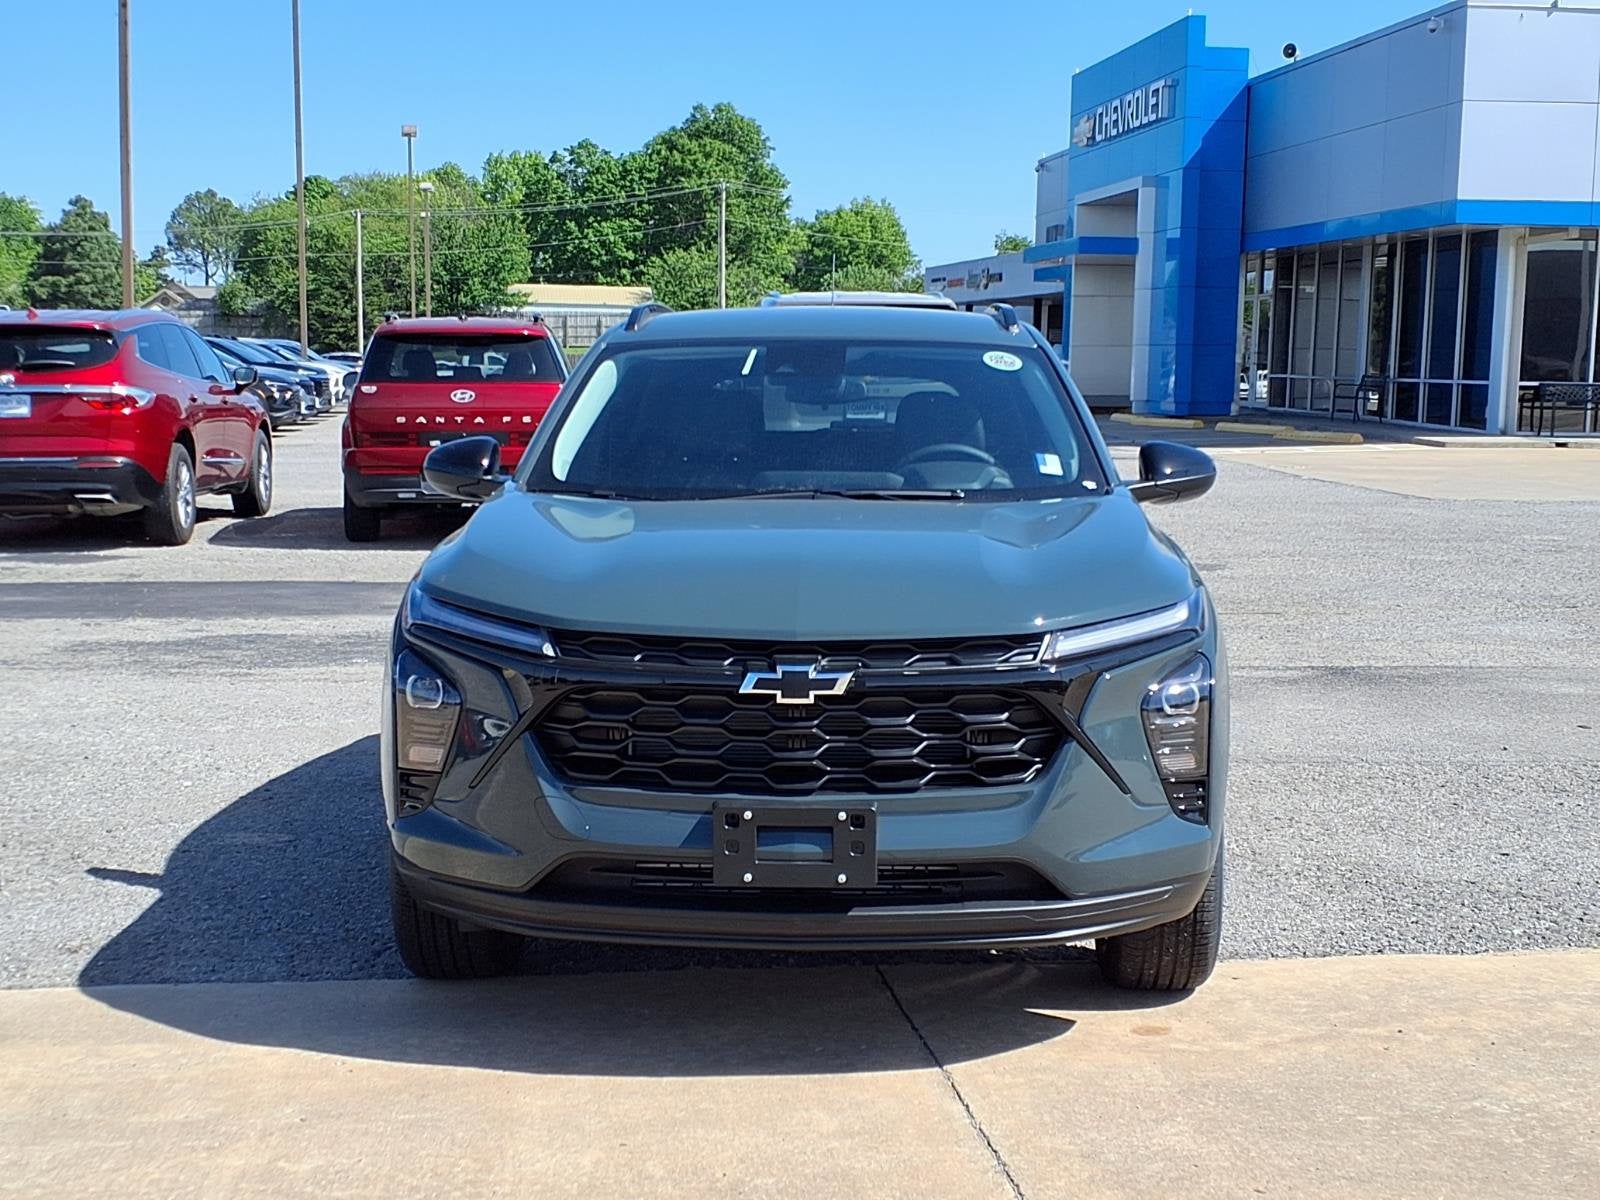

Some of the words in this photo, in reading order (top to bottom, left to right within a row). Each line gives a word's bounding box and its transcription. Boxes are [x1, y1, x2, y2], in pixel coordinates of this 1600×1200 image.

[1095, 79, 1166, 142] CHEVROLET
[396, 415, 485, 424] SANTA
[502, 415, 532, 424] FE
